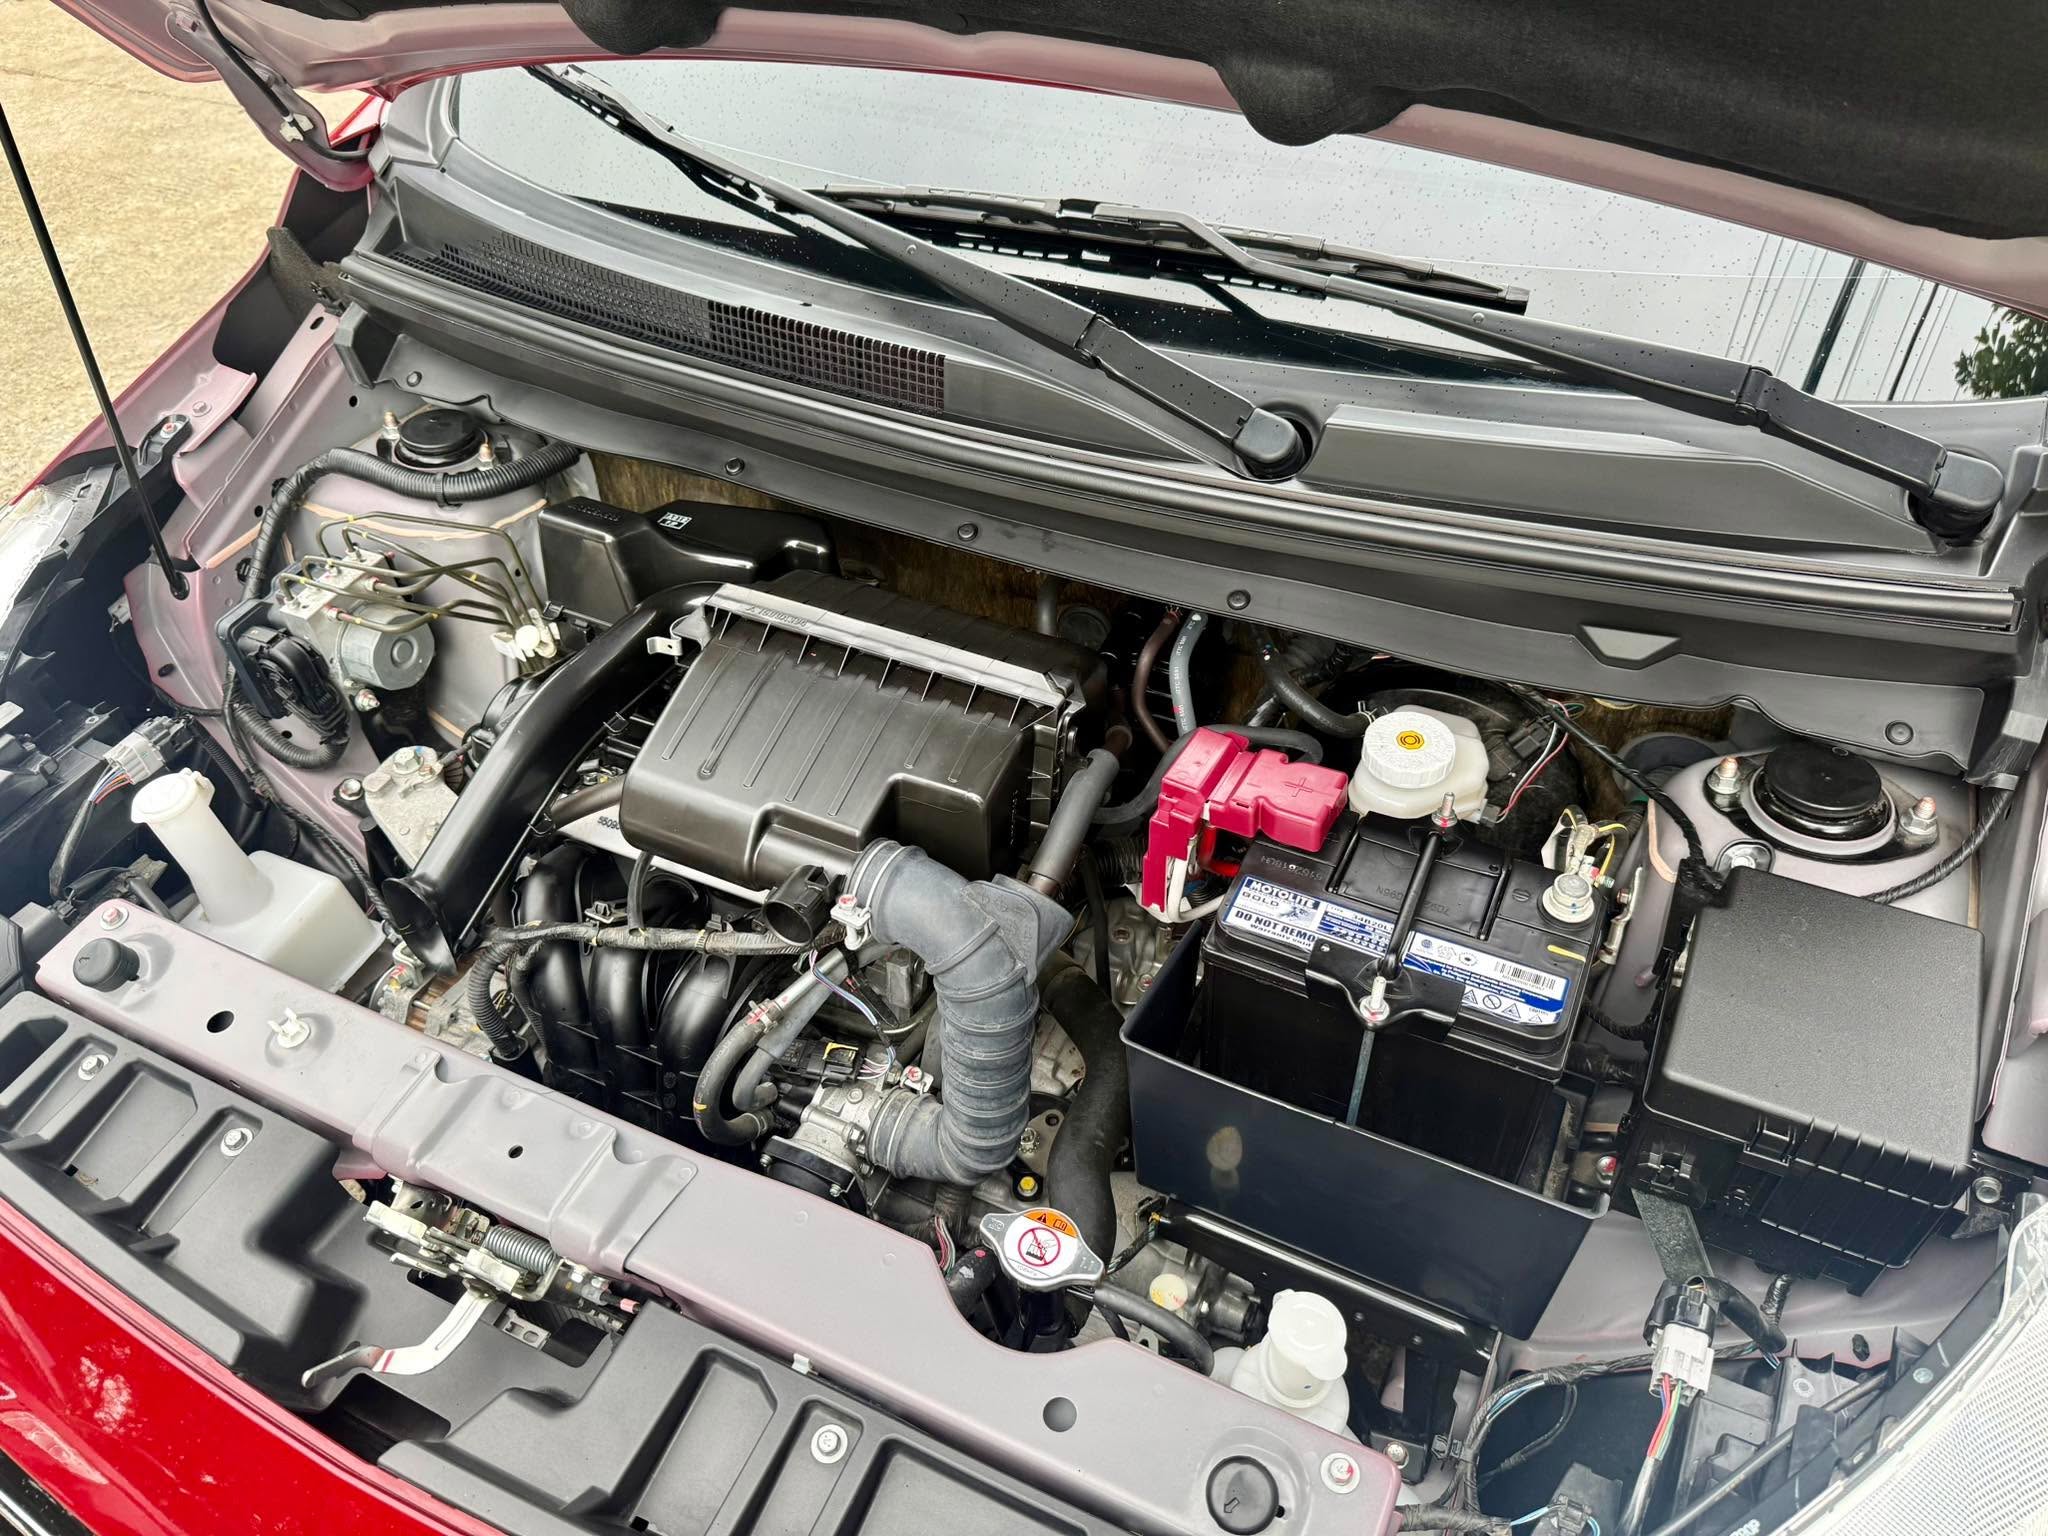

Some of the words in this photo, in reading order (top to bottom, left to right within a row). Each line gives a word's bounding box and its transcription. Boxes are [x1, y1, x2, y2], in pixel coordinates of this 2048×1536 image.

[1242, 890, 1280, 908] GOLD
[1250, 880, 1316, 909] MOTOLITE
[1234, 910, 1253, 922] DO
[1254, 916, 1280, 930] NOT
[1281, 924, 1317, 944] REMO
[1250, 923, 1292, 940] Warranty
